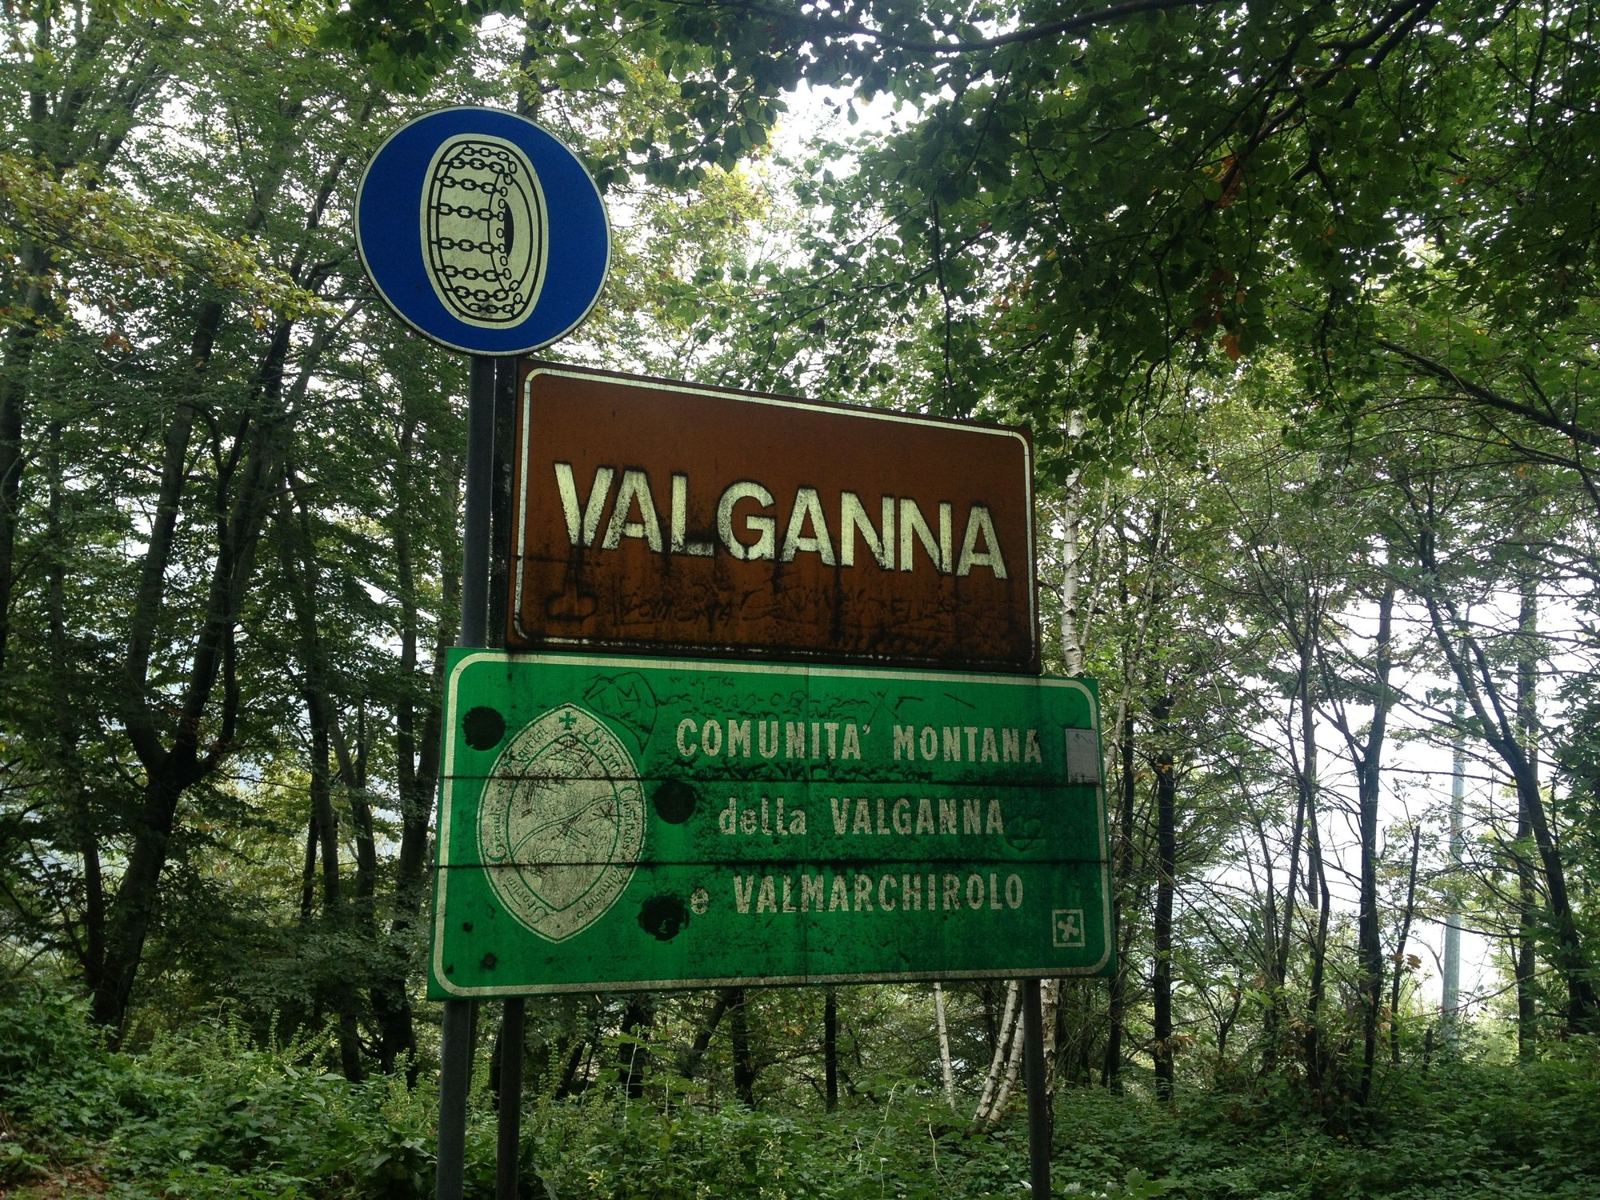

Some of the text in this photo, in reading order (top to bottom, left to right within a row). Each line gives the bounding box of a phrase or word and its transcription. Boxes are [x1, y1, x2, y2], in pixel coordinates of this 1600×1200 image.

[554, 462, 1008, 579] VALGANNA
[893, 725, 1043, 764] MONTANA
[718, 797, 1005, 836] della VALGANNA
[690, 873, 1024, 914] e VALMARCHIROLO
